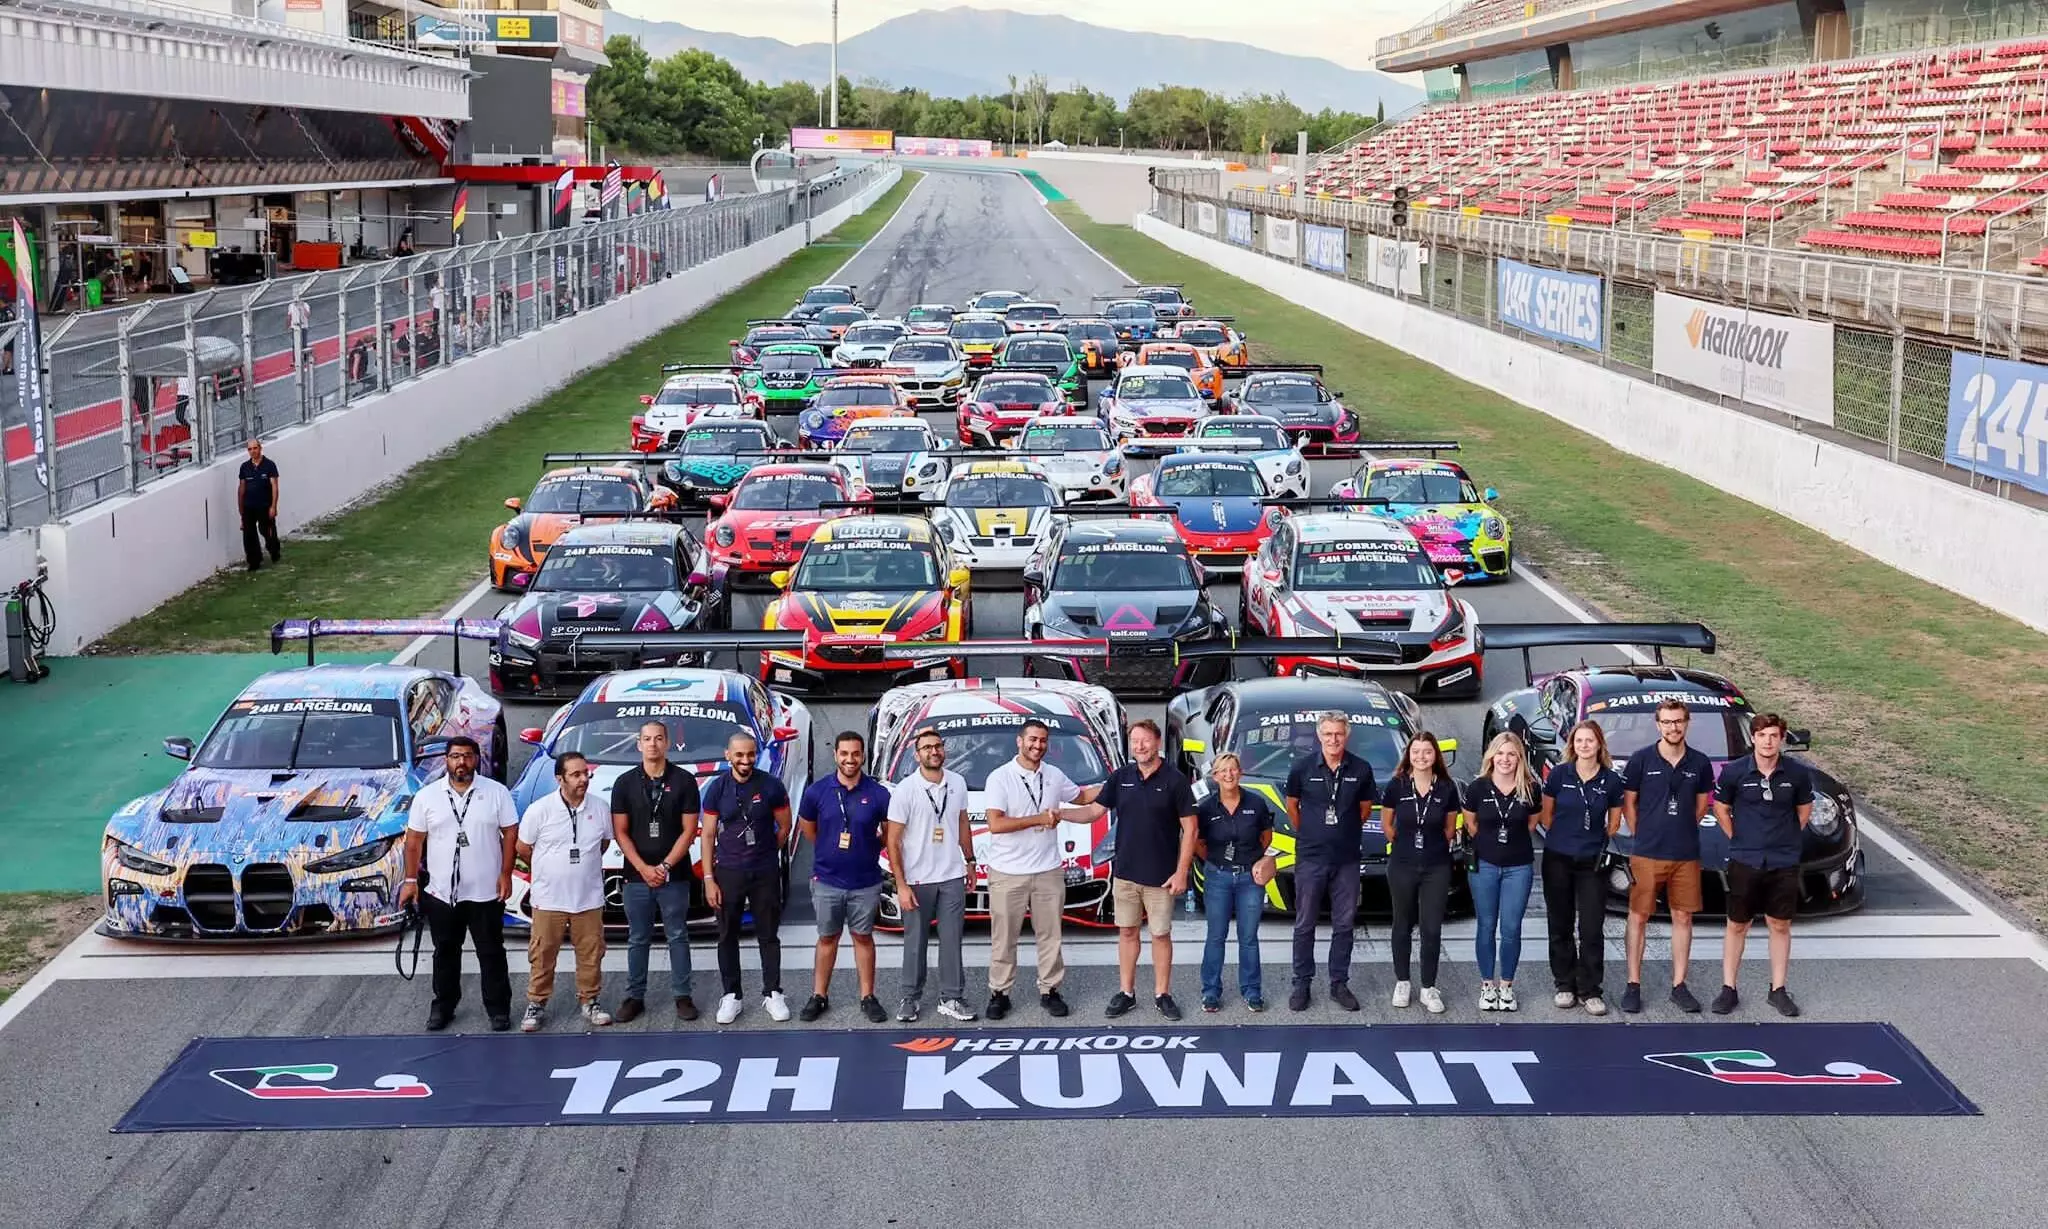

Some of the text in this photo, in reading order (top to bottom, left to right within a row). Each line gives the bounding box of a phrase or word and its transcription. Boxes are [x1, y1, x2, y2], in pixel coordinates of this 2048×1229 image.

[1502, 267, 1598, 342] 24H SERIES
[756, 473, 827, 482] 24H BARCELONA
[983, 472, 1034, 480] BARCELONA
[1384, 469, 1456, 478] 24H BARCELONA
[824, 541, 912, 551] 24H BARCELONA
[1078, 543, 1167, 553] 24H BARCELONA
[1335, 542, 1420, 553] COBRA-TOOLS
[564, 547, 653, 556] 24H BARCELONA
[1319, 554, 1408, 564] 24H BARCELONA
[551, 626, 566, 634] SP
[1608, 695, 1639, 708] 24H
[249, 702, 373, 715] 24H BARCELONA
[616, 705, 737, 723] 24H BARCELONA
[938, 718, 967, 730] 24H
[1260, 714, 1290, 726] 24H
[549, 1050, 1540, 1115] 12H KUWAIT
